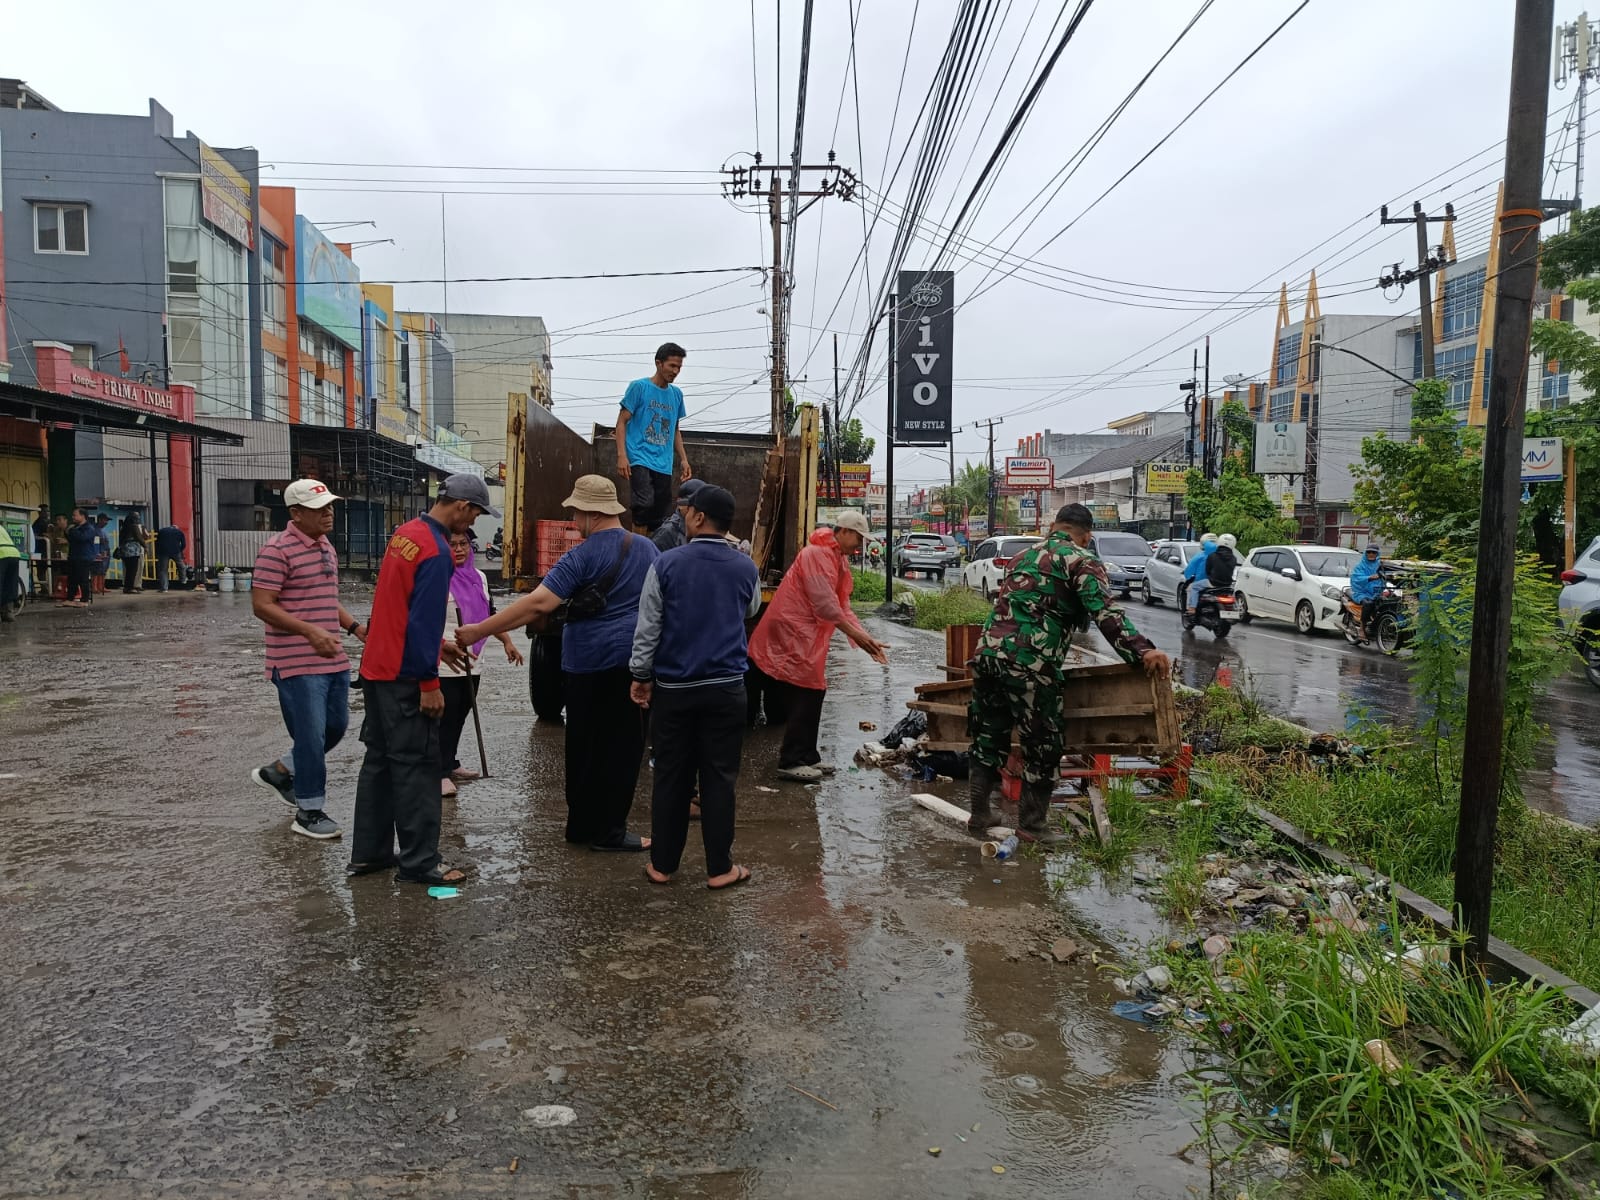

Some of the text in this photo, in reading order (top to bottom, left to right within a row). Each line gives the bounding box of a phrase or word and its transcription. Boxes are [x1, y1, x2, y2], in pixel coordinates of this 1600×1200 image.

[103, 379, 137, 401] PRIMA
[143, 389, 173, 409] INDAH
[904, 420, 945, 429] NEW STYLE
[1151, 464, 1172, 472] ONE
